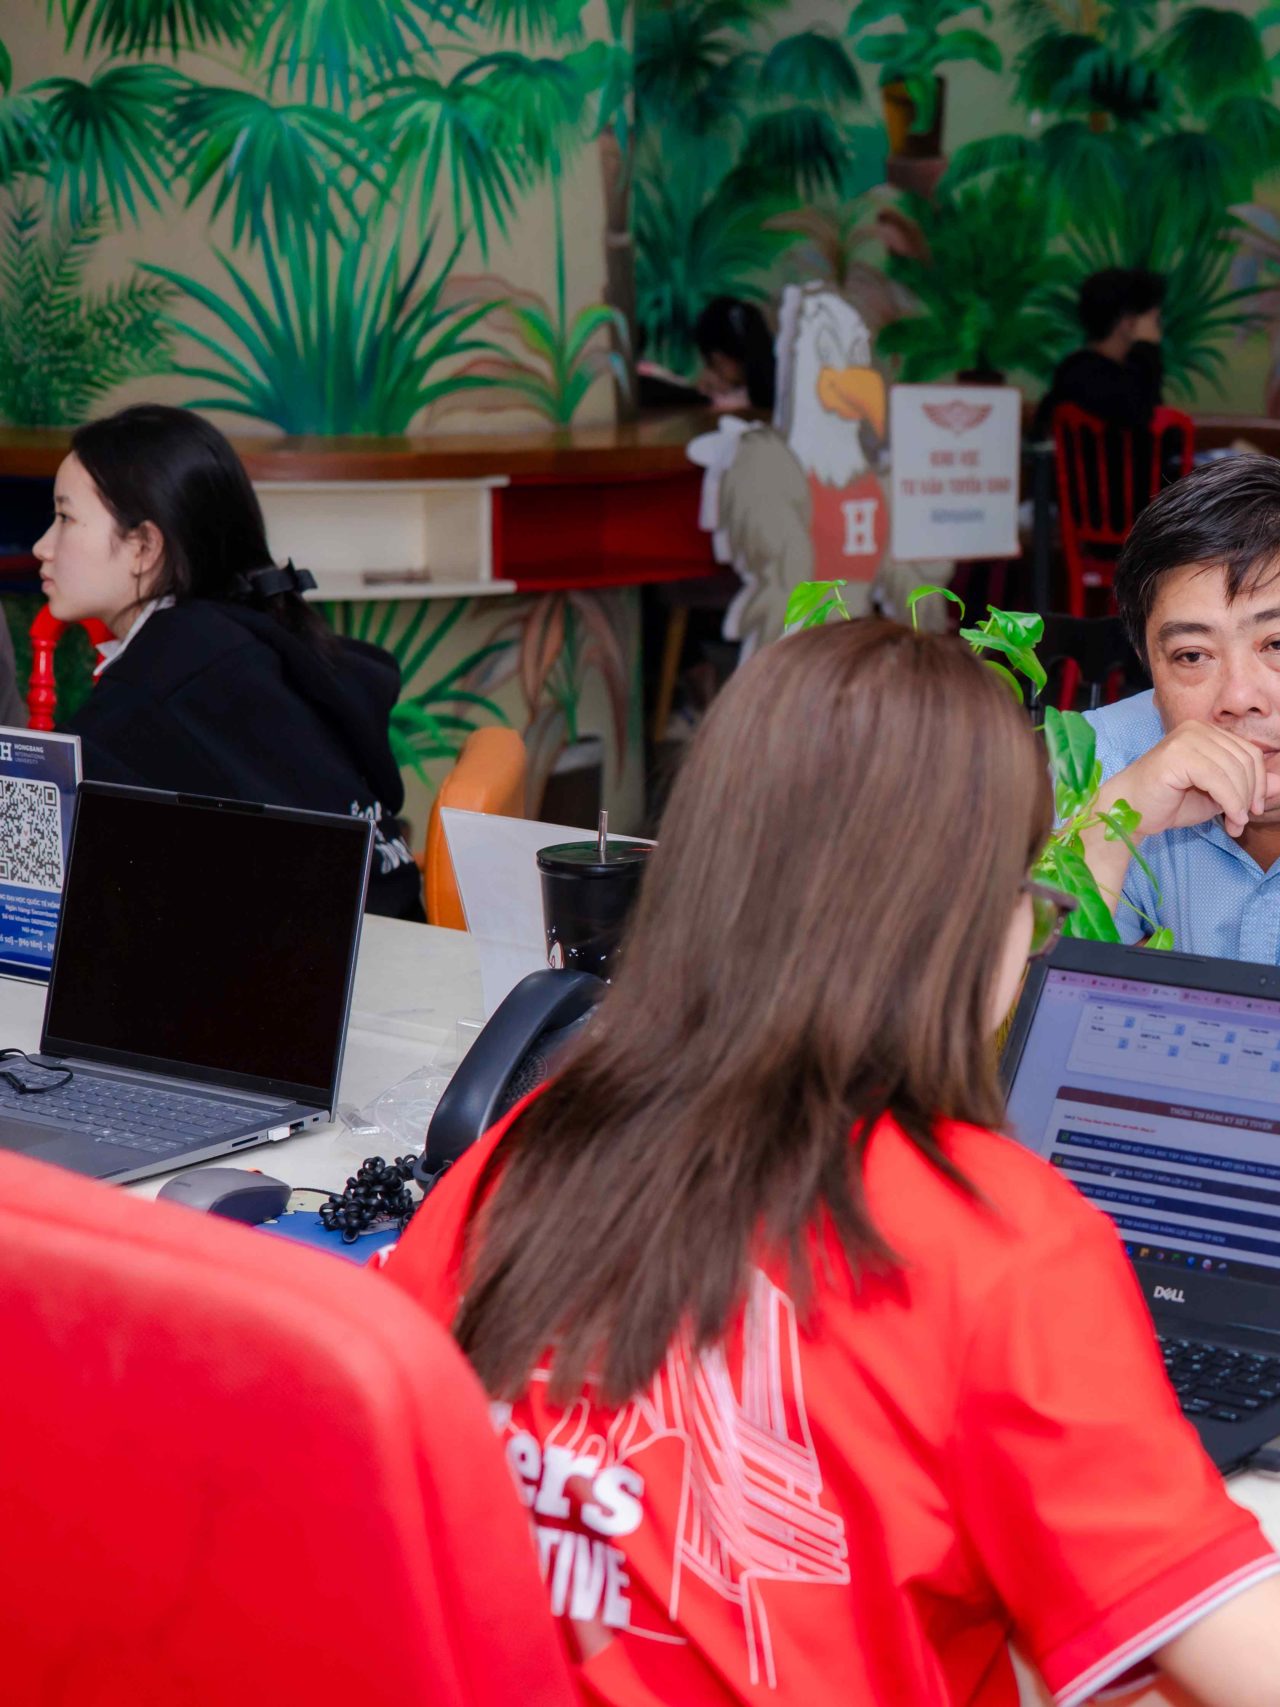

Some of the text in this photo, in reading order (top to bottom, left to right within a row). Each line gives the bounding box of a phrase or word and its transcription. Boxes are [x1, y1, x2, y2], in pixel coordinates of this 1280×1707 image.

[841, 499, 878, 555] H
[14, 744, 45, 753] HONGBANG
[1153, 1285, 1186, 1303] DELL
